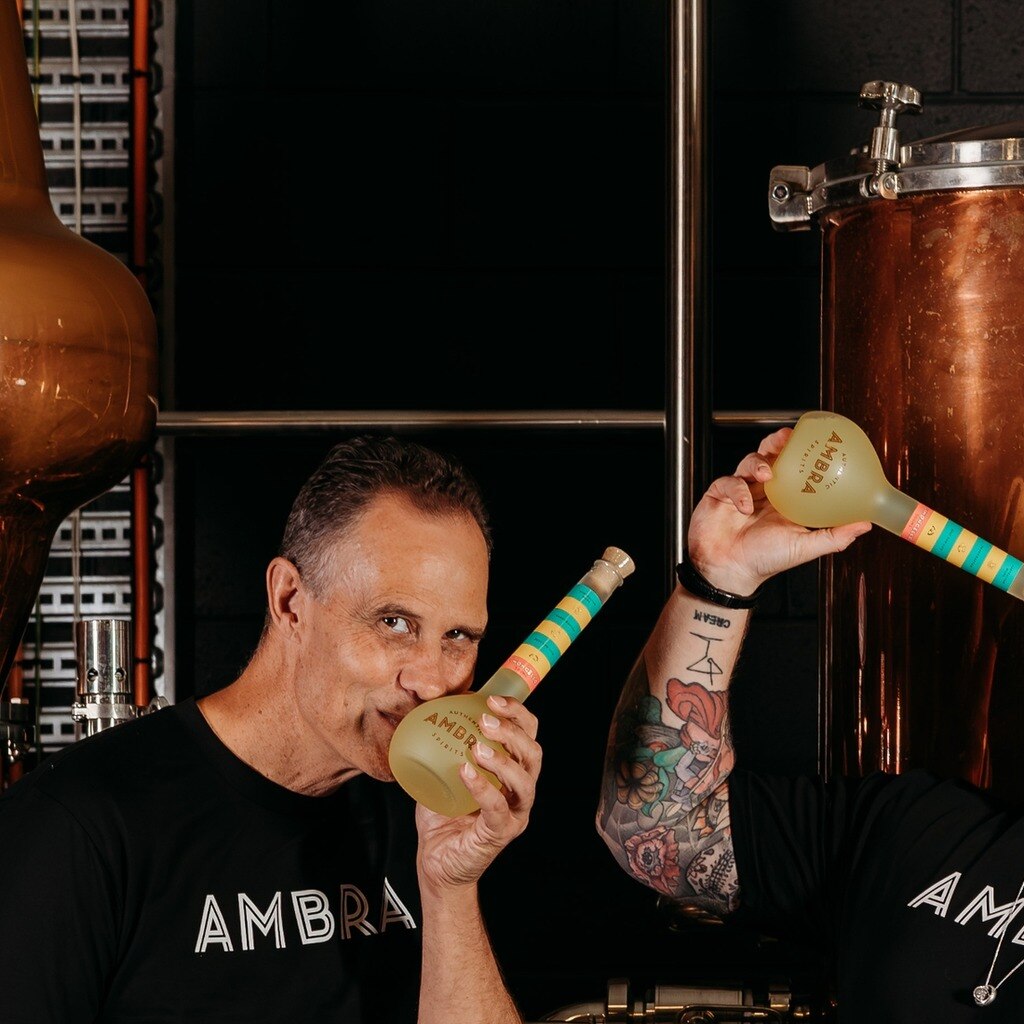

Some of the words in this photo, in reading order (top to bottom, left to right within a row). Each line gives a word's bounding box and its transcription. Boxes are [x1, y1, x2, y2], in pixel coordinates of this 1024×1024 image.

[801, 430, 843, 494] AMBRA
[693, 609, 731, 629] CREAM
[423, 712, 477, 750] AMBR
[432, 732, 464, 757] SPIRITS
[195, 877, 417, 952] AMBRA
